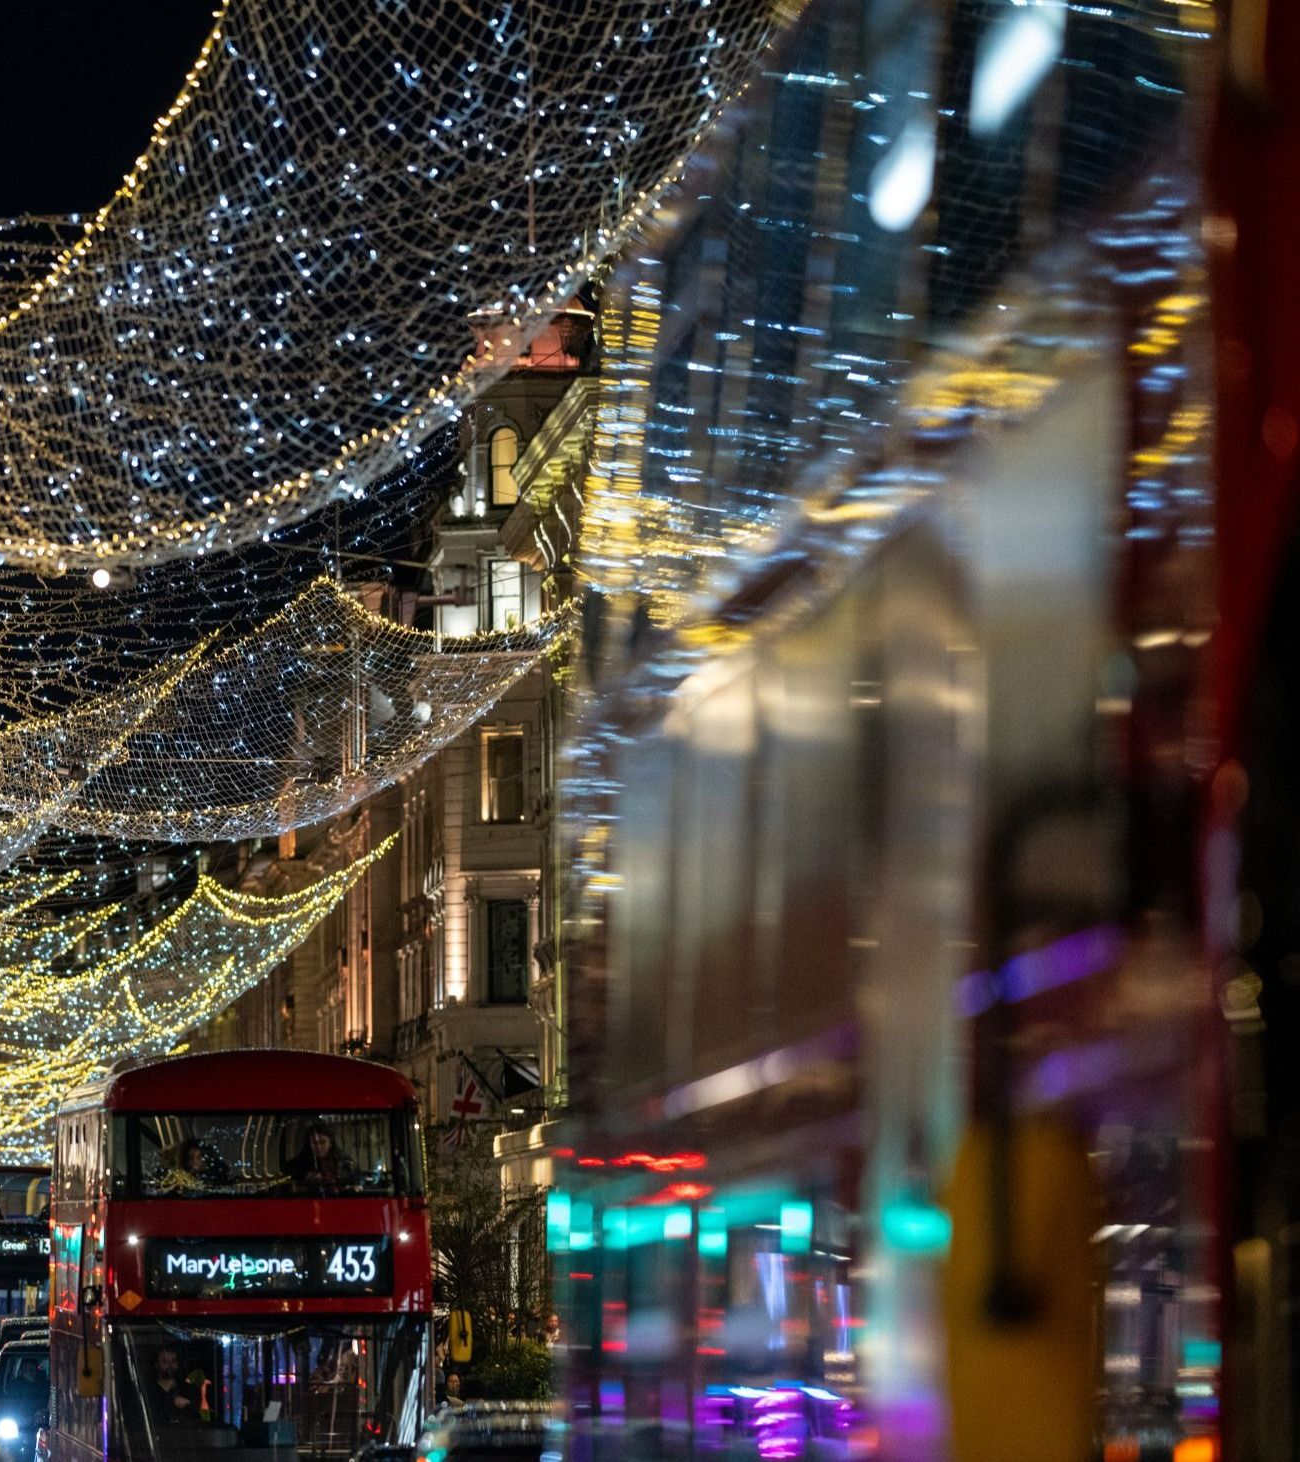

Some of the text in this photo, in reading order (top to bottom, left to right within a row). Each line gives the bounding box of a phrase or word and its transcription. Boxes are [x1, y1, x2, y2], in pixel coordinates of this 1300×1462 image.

[2, 1240, 27, 1250] Green
[166, 1246, 376, 1282] Marylebone 453
